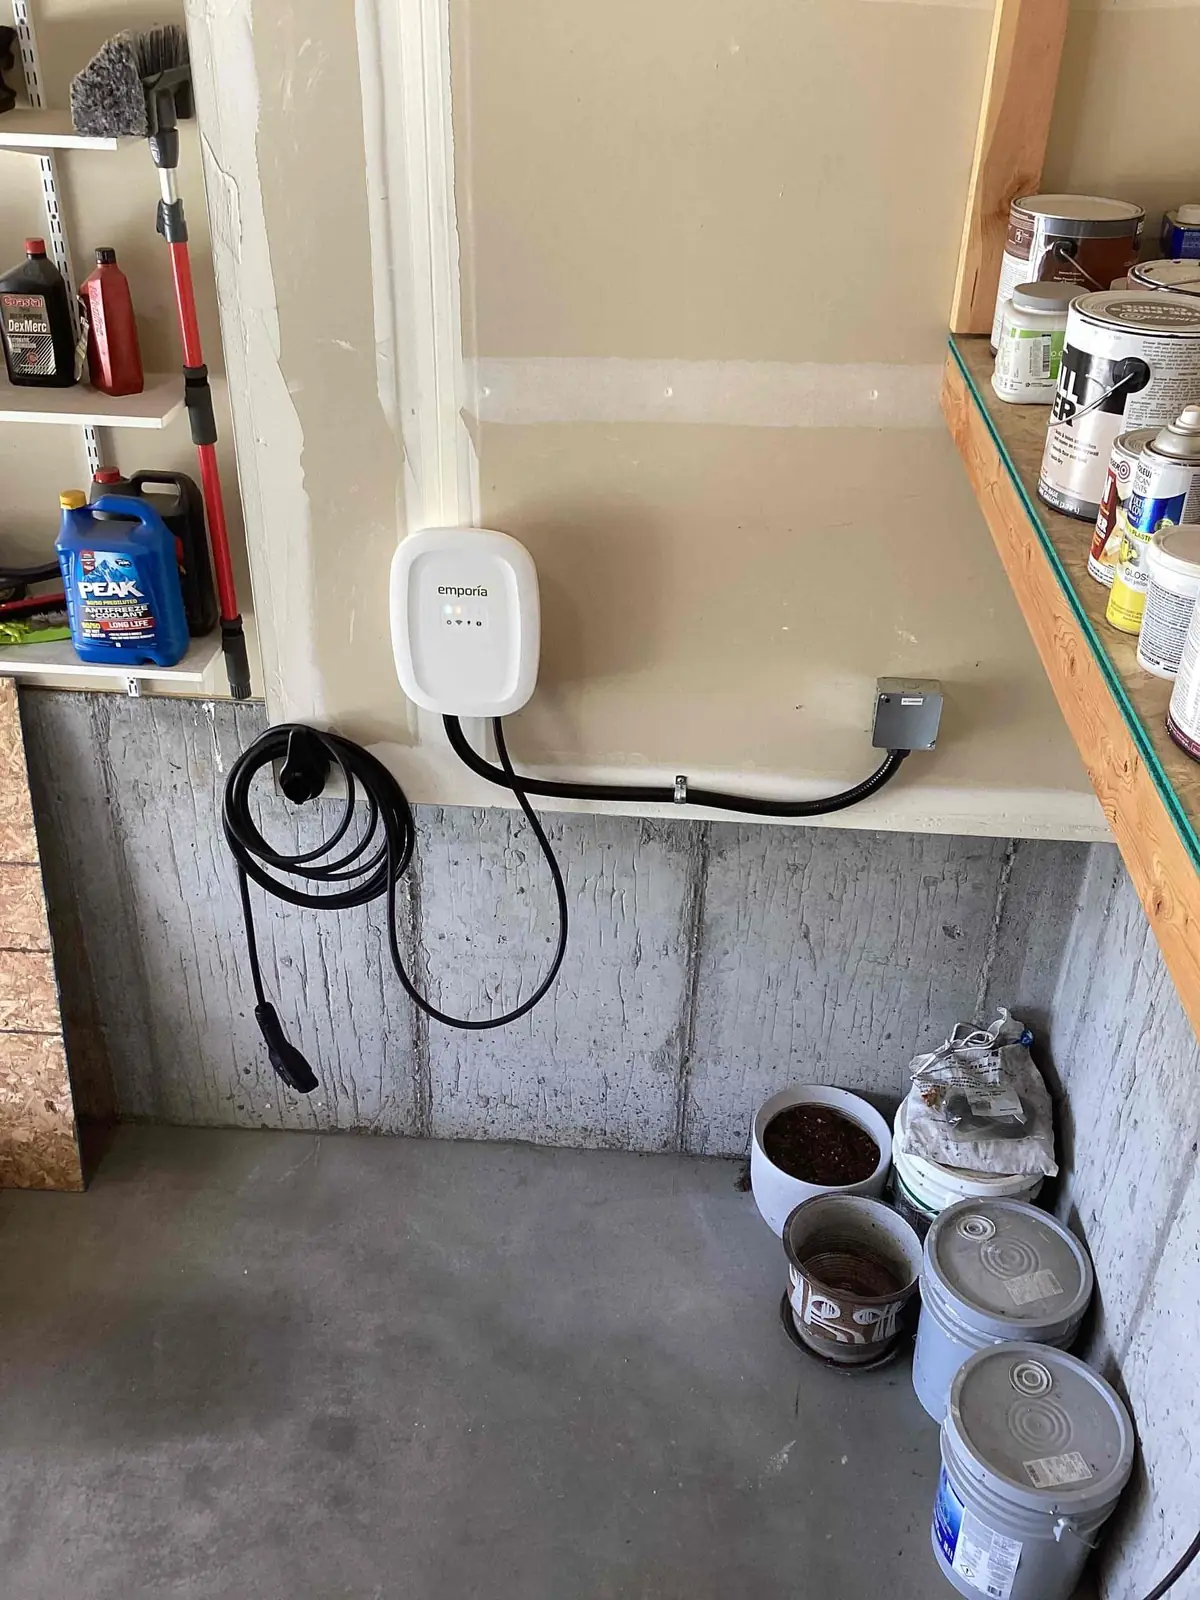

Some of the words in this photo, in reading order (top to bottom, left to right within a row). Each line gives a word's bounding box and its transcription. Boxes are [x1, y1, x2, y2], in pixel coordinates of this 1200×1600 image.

[3, 295, 43, 308] Coastal
[8, 319, 47, 333] DexMerc
[77, 581, 145, 600] PEAK
[437, 584, 488, 598] emporía
[85, 605, 148, 613] ANTIFREEZE
[109, 621, 129, 629] LONG
